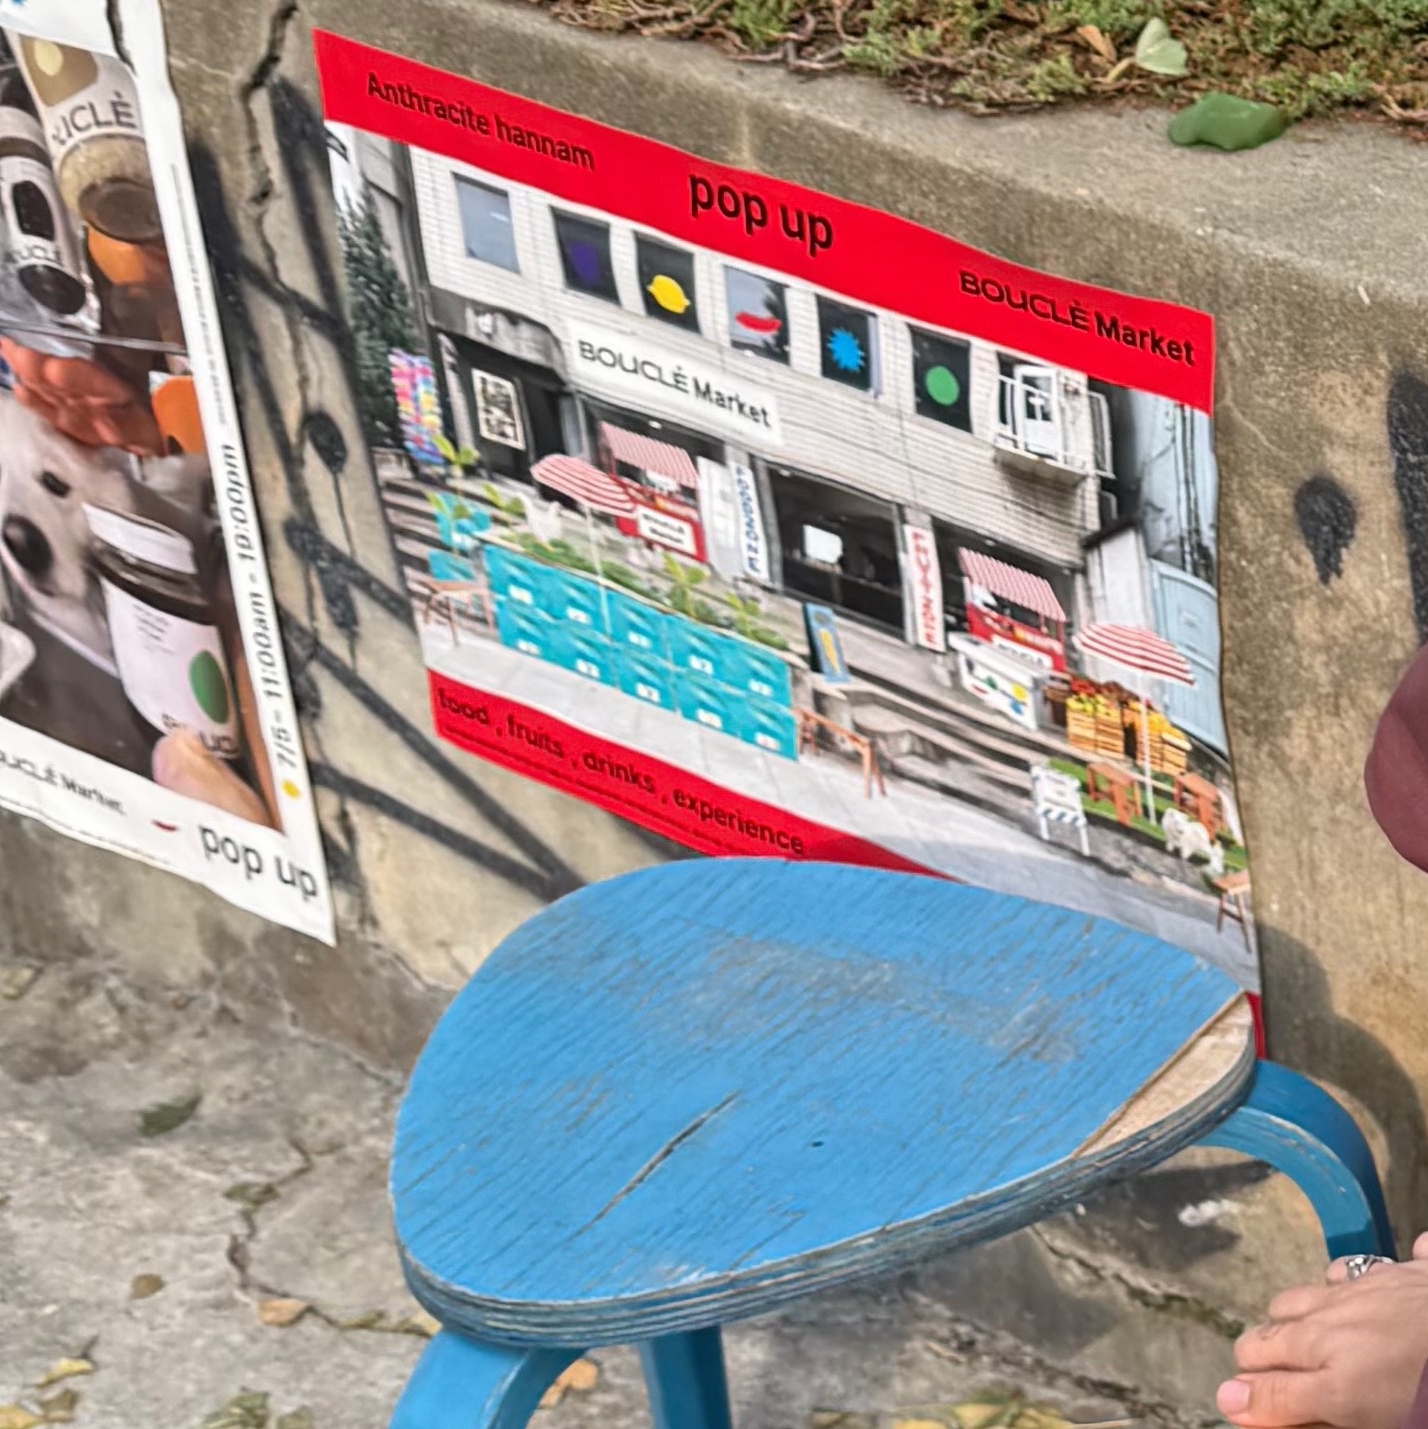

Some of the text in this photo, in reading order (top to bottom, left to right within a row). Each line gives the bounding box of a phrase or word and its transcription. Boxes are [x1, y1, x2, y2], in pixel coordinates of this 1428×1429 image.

[367, 71, 595, 170] Anthracite hannam
[688, 174, 835, 256] pop up
[1095, 308, 1196, 368] Market
[692, 377, 772, 428] Market
[507, 714, 564, 759] fruits
[583, 749, 656, 794] drinks
[673, 786, 804, 854] experience
[199, 824, 319, 902] pop up
